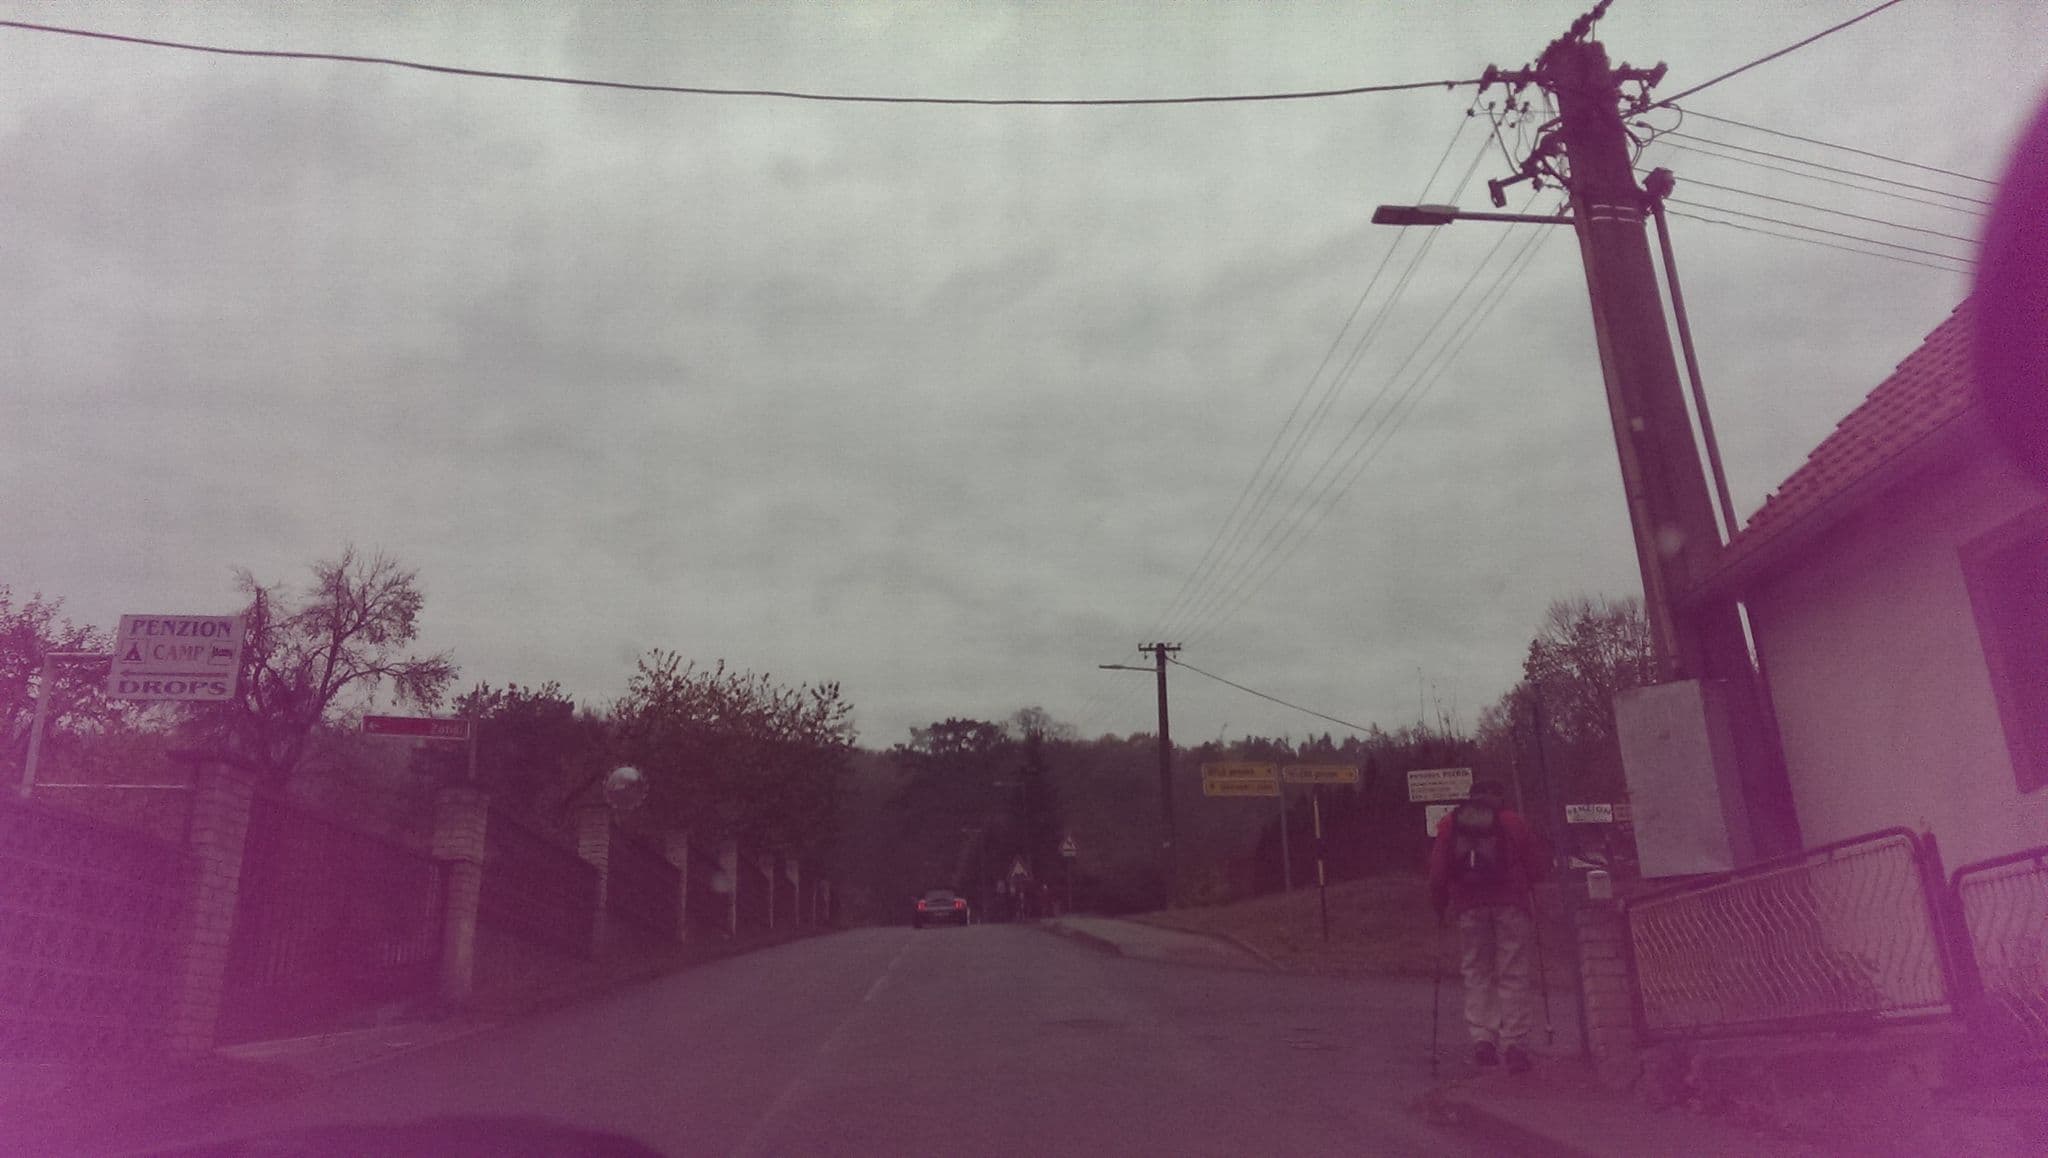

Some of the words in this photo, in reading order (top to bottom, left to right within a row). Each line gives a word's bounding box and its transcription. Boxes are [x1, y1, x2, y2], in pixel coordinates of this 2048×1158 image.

[129, 619, 232, 638] PENZION
[153, 644, 204, 661] CAMP
[118, 680, 227, 695] DROPS
